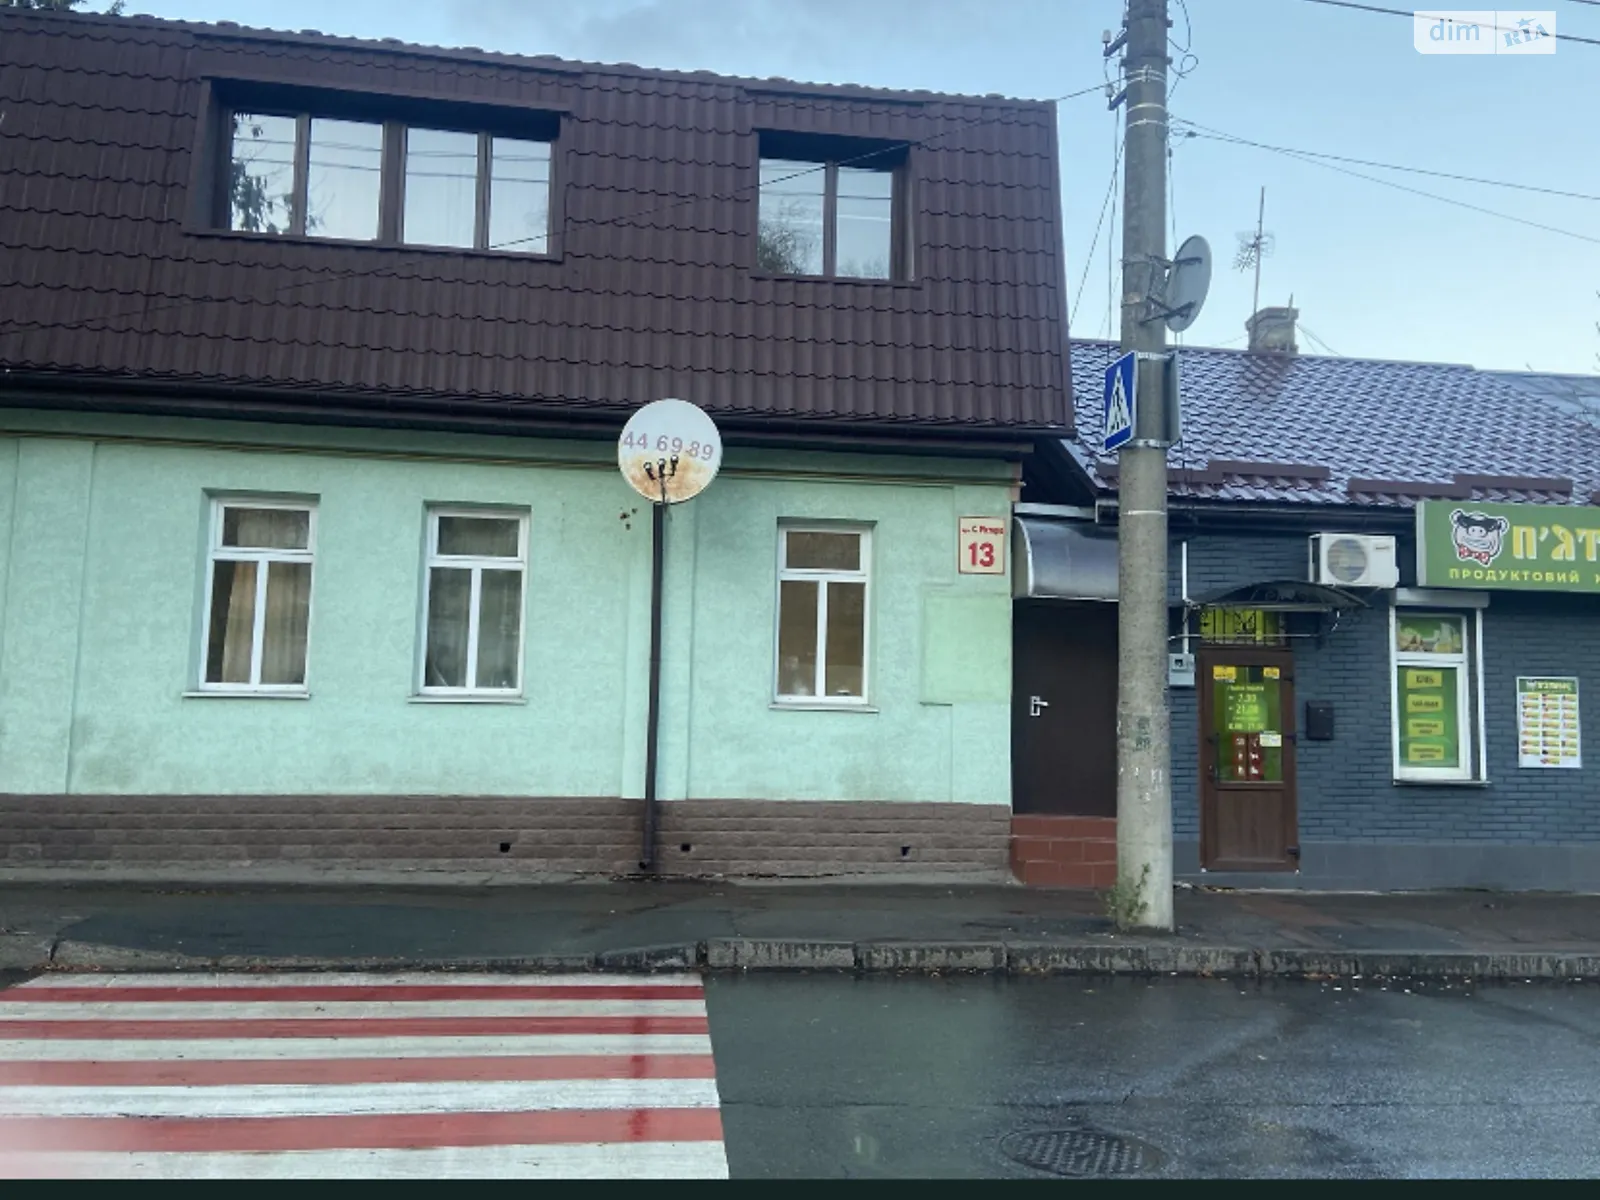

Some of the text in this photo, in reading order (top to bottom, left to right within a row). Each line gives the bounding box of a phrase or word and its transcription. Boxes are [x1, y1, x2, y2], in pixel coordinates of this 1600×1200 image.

[623, 431, 714, 461] 44 69 89
[968, 542, 995, 567] 13
[1449, 568, 1580, 584] ПРОДУКТОВИЙ
